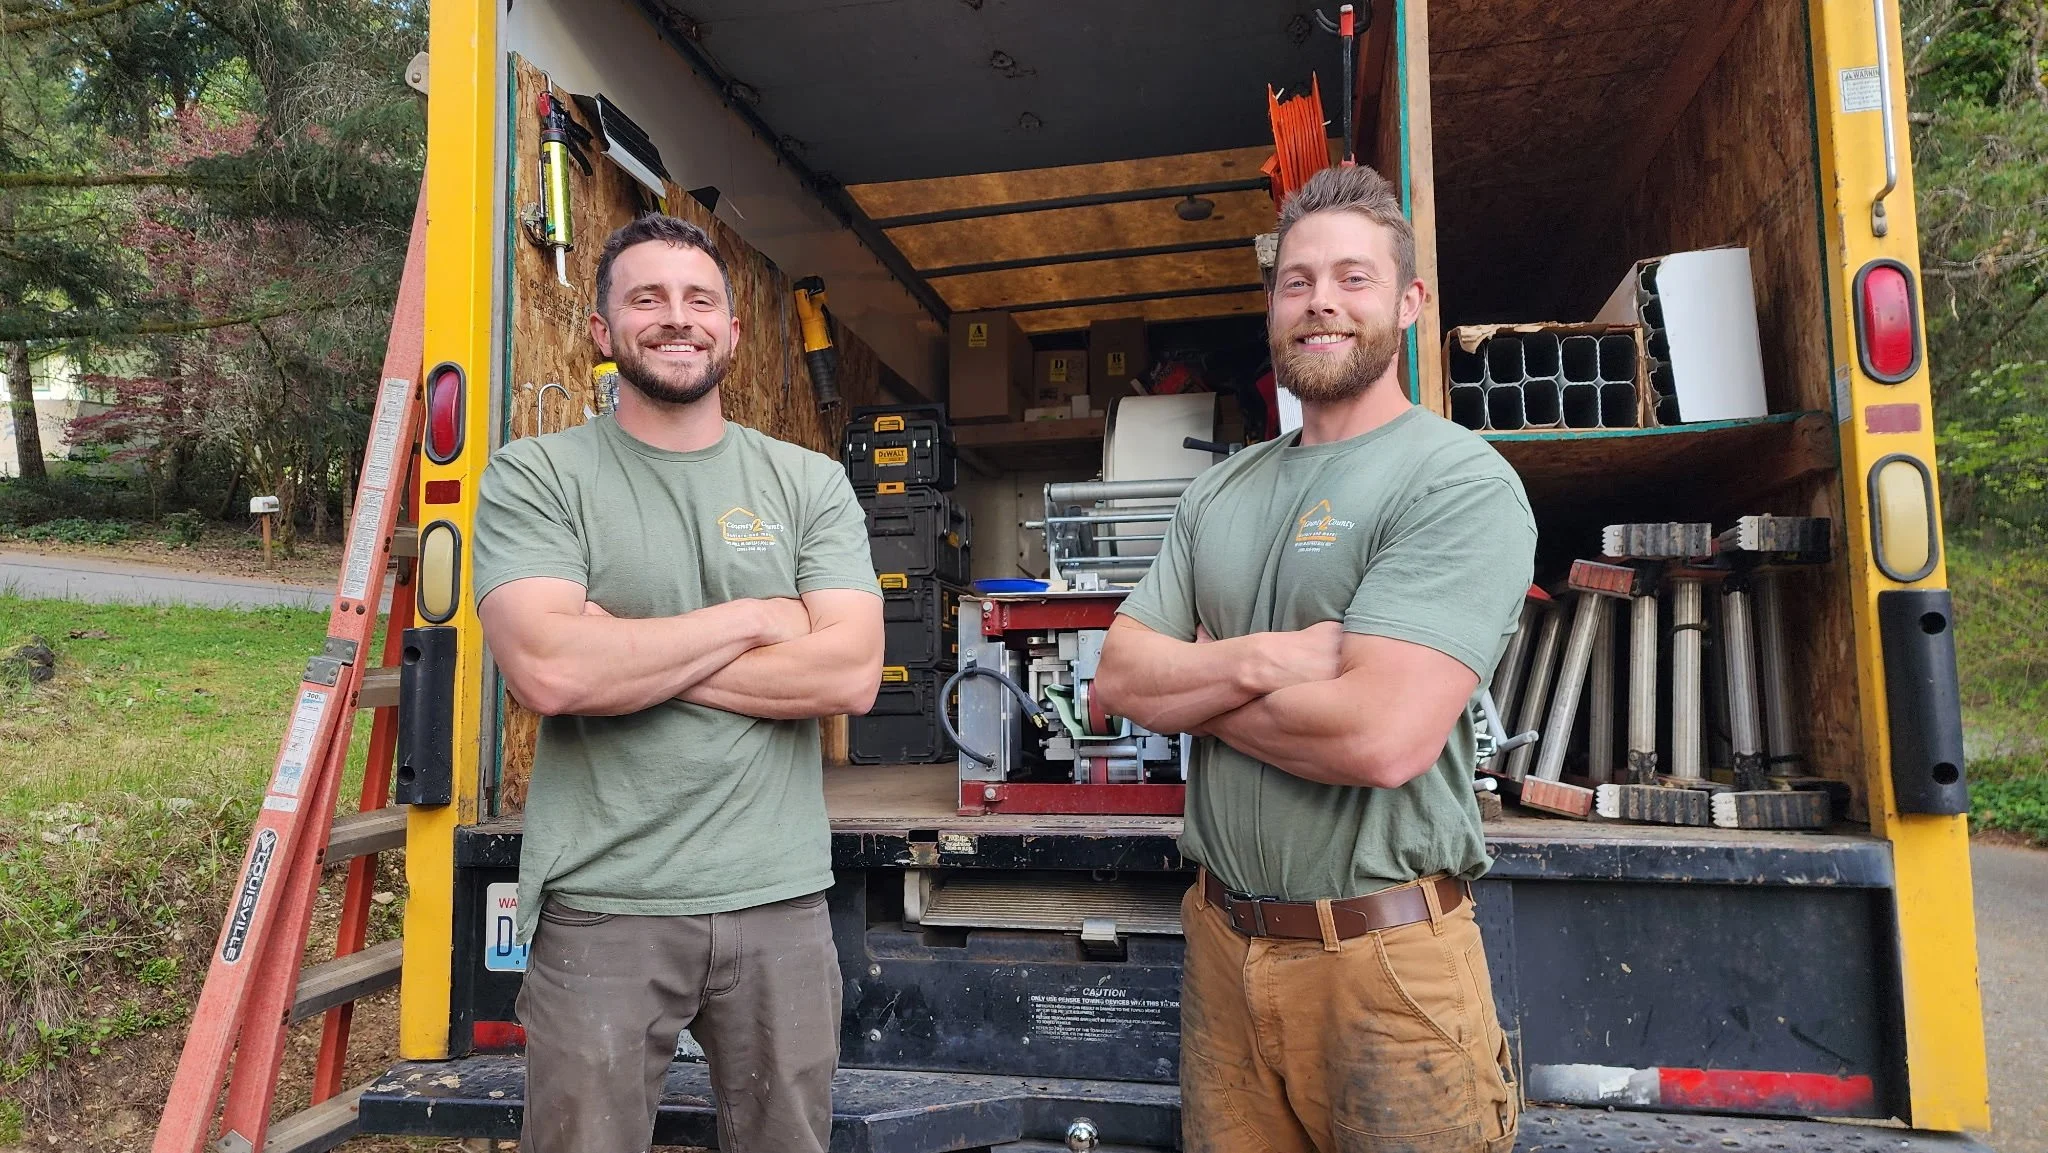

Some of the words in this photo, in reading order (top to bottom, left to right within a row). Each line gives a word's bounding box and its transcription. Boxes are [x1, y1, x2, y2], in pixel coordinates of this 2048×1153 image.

[1853, 70, 1880, 79] WARNIN
[878, 450, 905, 458] DEWALT
[752, 518, 763, 532] 2
[1328, 518, 1355, 530] County
[226, 847, 270, 960] LOUISVILLE
[1082, 987, 1127, 998] CAUTION
